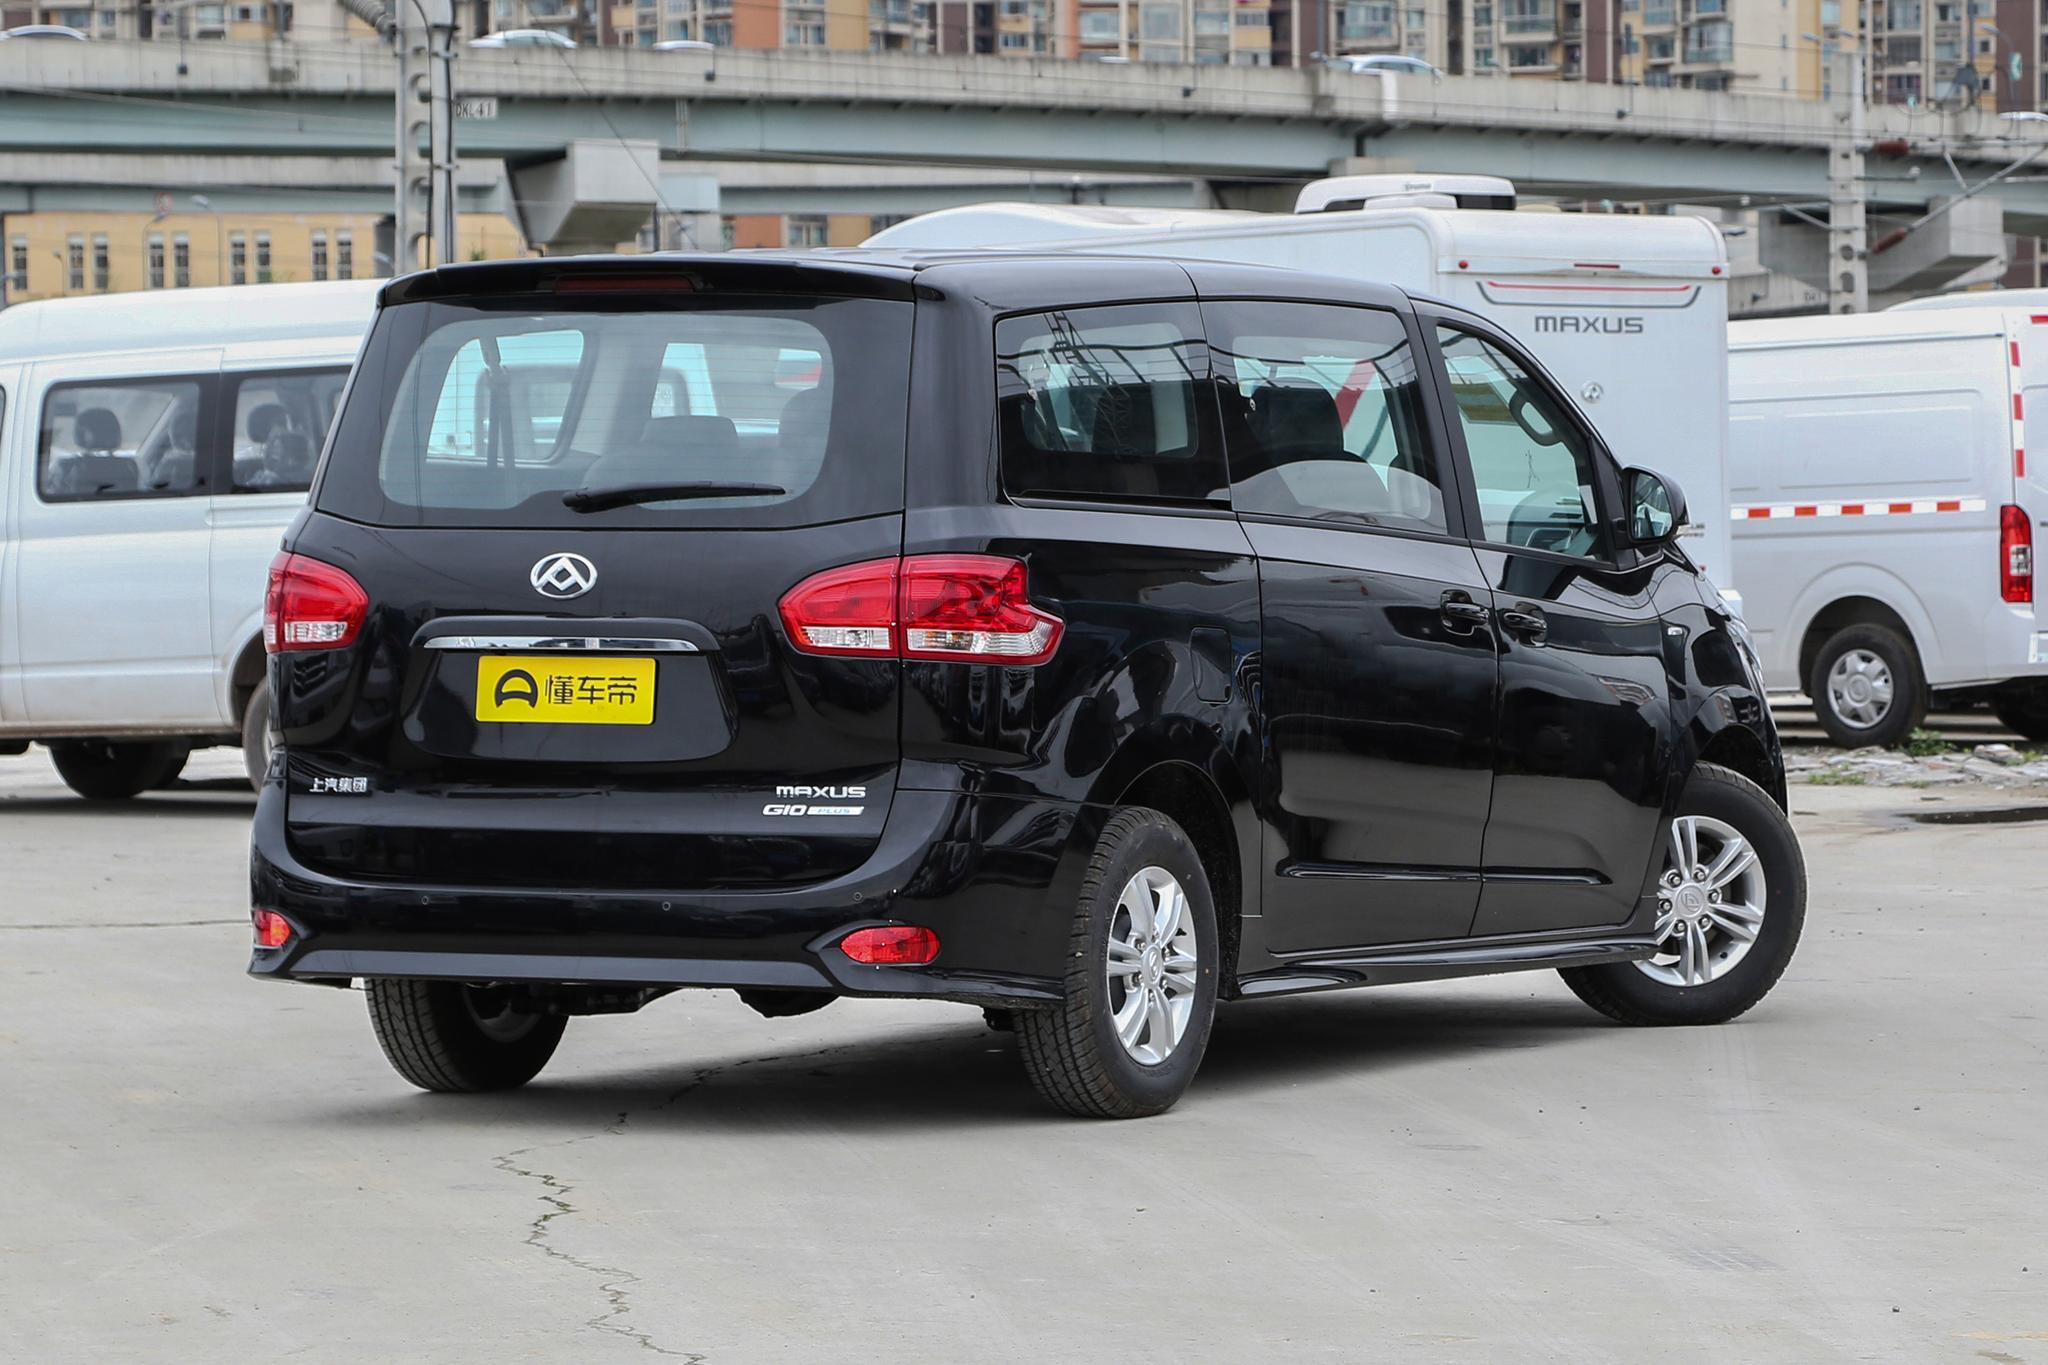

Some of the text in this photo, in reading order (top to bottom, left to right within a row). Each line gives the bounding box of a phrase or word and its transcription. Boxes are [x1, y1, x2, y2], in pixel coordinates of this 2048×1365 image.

[1535, 316, 1643, 333] MAXUS
[545, 675, 637, 705] 懂车帝
[309, 777, 368, 793] 上汽集团
[776, 786, 866, 799] MAXUS
[763, 804, 807, 816] G10
